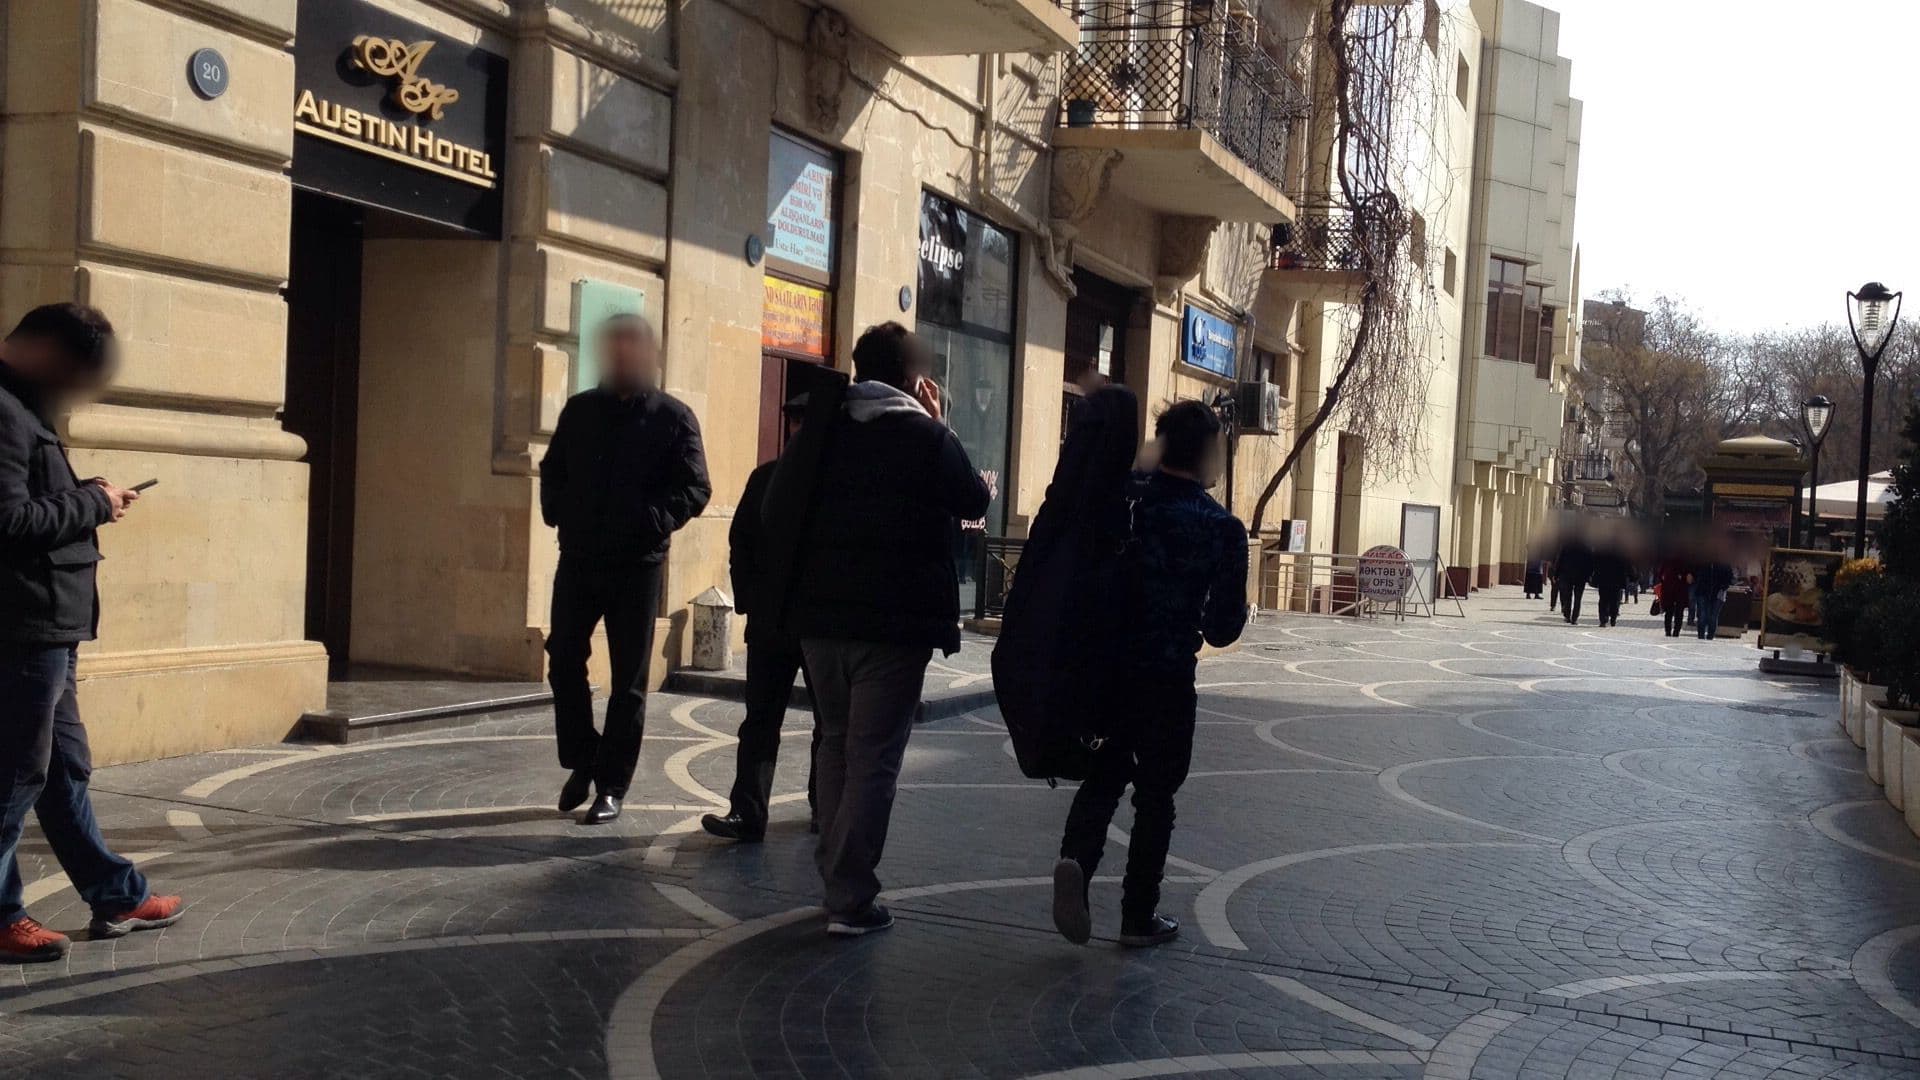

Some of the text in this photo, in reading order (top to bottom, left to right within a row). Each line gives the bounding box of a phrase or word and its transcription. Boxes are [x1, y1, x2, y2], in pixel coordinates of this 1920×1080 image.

[203, 62, 220, 82] 20
[295, 89, 497, 179] AUSTIN HOTEL
